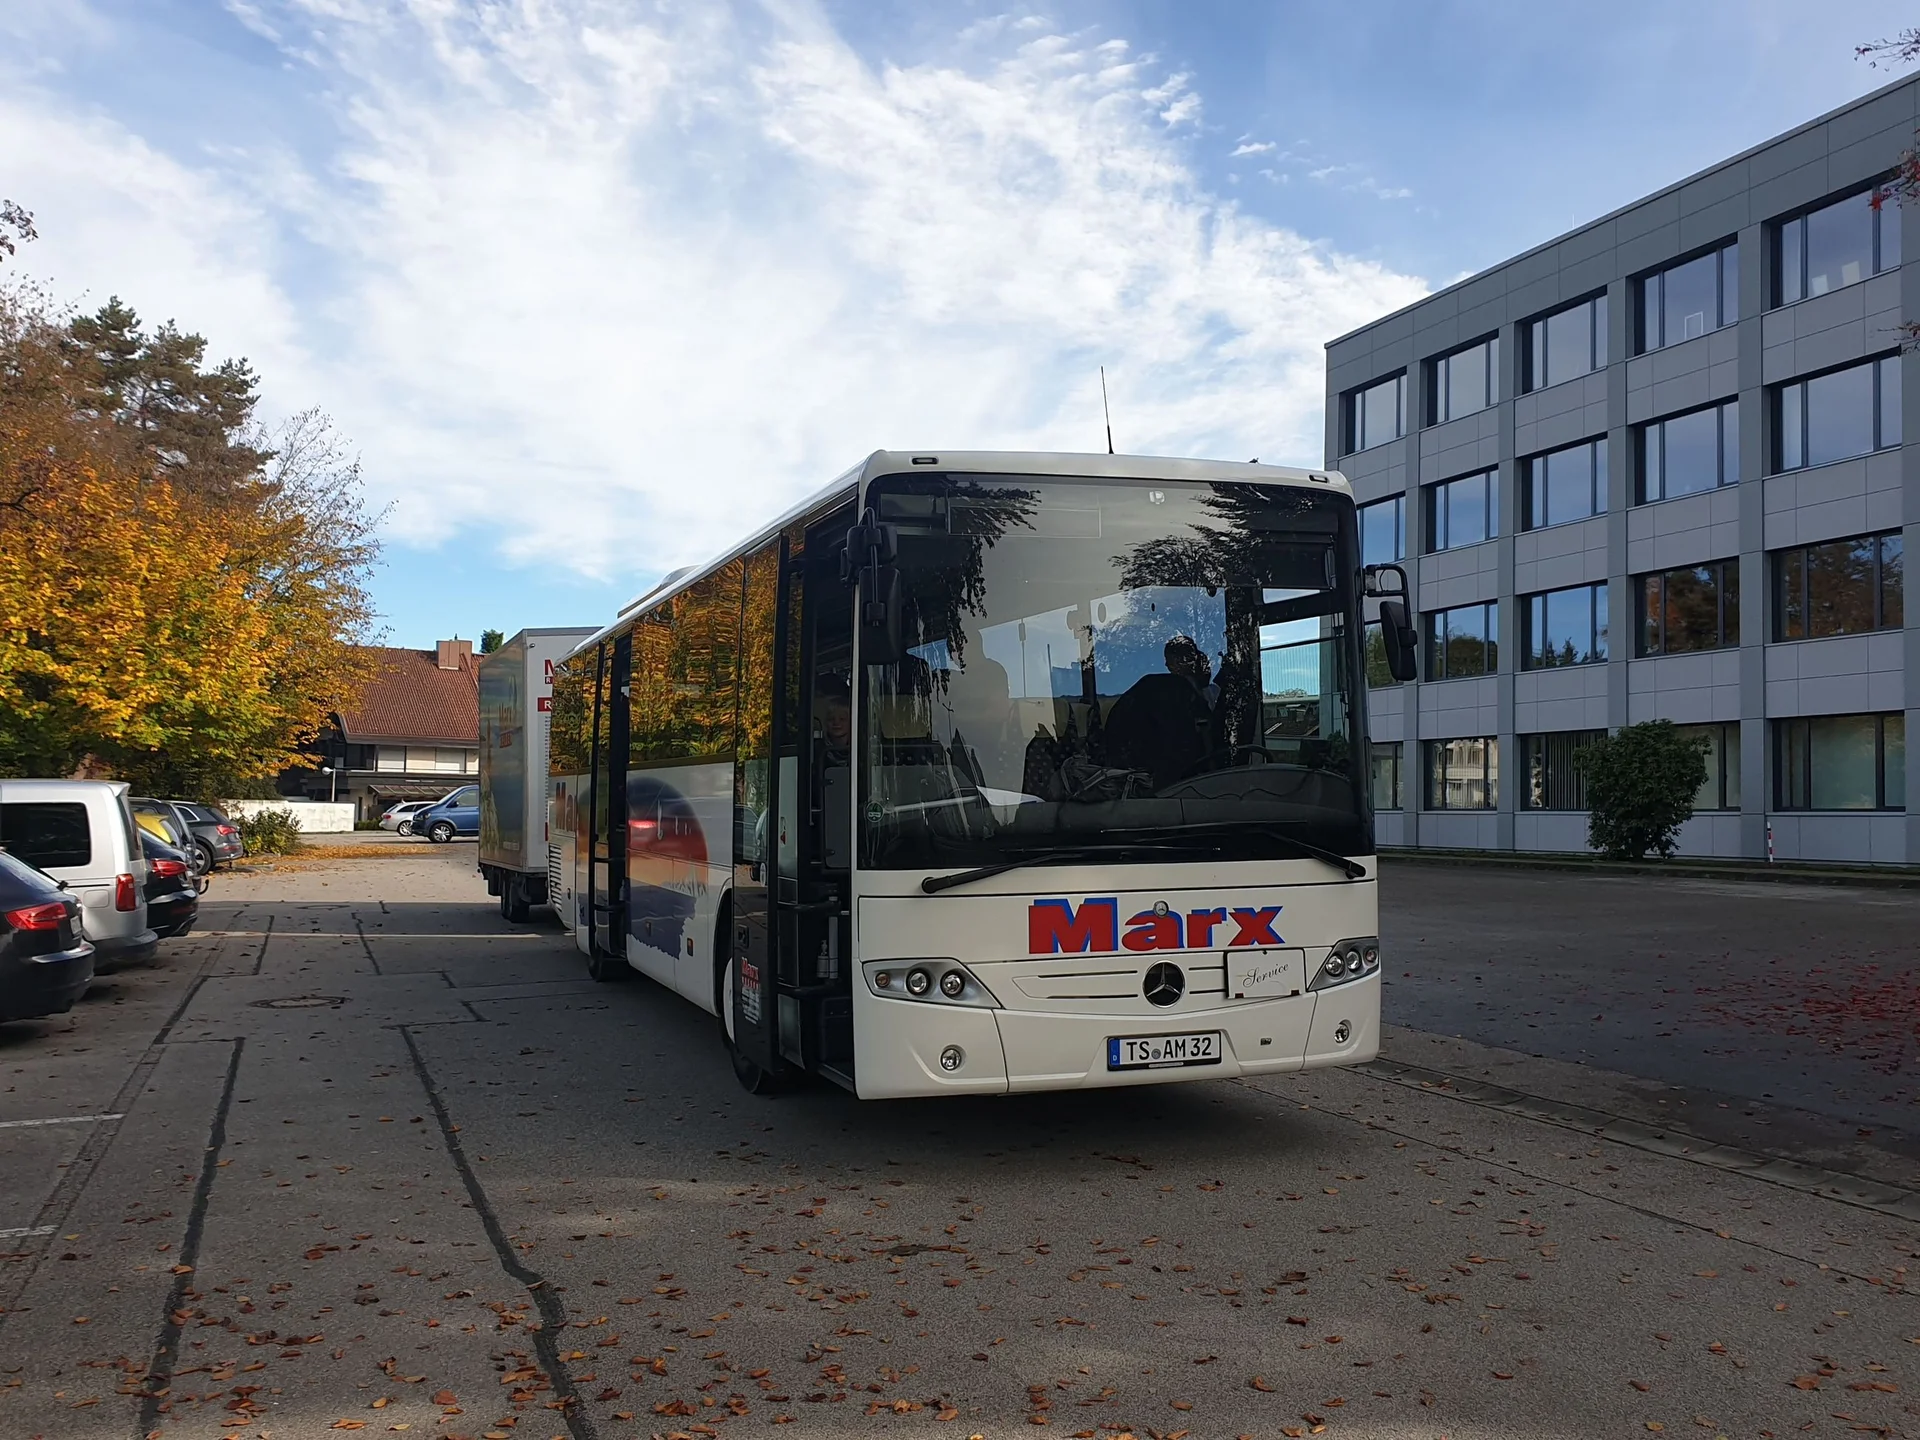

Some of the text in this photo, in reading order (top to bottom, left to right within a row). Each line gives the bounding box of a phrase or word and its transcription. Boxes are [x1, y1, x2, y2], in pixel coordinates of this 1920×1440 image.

[1028, 897, 1286, 954] Marx
[1242, 963, 1289, 988] Service
[1126, 1037, 1212, 1061] TS AM 32
